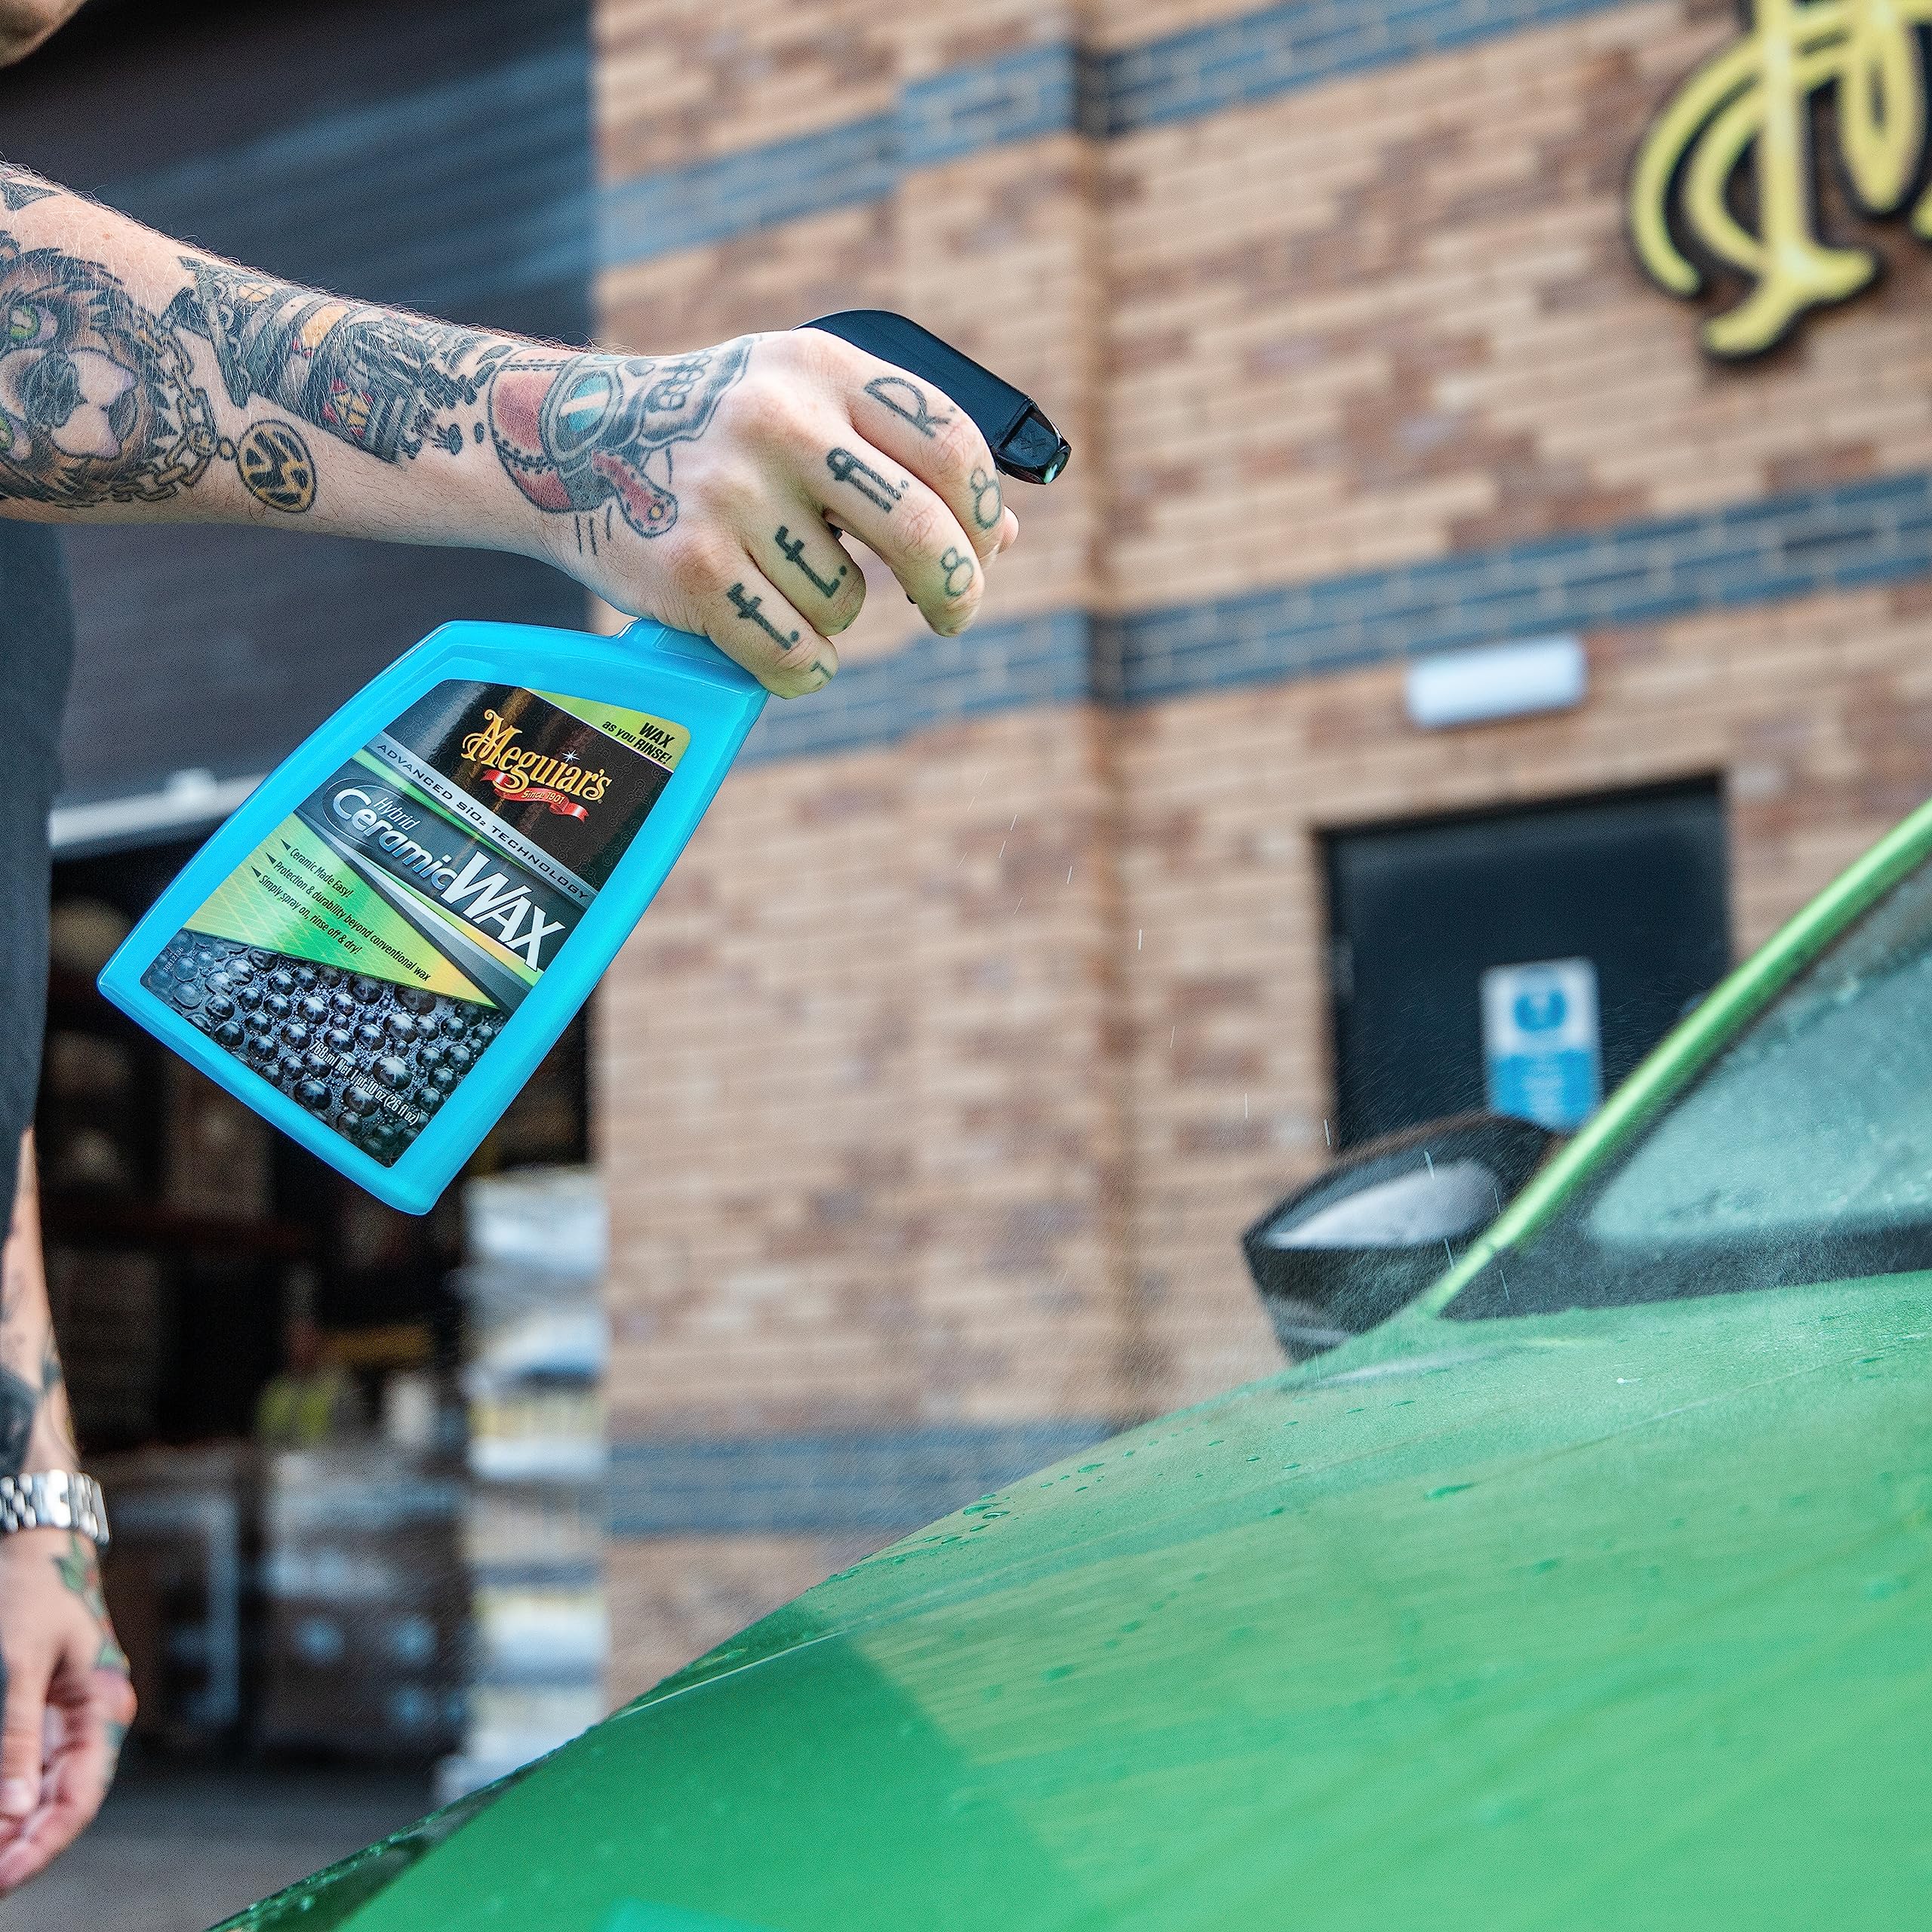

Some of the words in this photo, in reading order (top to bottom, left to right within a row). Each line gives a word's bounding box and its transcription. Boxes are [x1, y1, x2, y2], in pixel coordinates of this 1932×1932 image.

[460, 709, 612, 801] Meguiar's
[601, 721, 617, 732] as
[615, 728, 636, 743] you
[633, 738, 672, 764] RINSE!
[639, 721, 675, 749] WAX
[374, 797, 420, 830] Hybrid
[377, 743, 454, 801] ADVANCED
[491, 824, 589, 900] TECHNOLOGY
[521, 790, 545, 799] Since
[546, 791, 566, 804] 1901
[290, 848, 315, 872] Ceramic
[314, 867, 334, 885] Made
[332, 879, 354, 898] Easy!
[332, 788, 458, 891] Ceramic
[439, 850, 566, 972] WAX
[259, 875, 284, 900] Simply
[280, 892, 303, 912] spray
[298, 906, 310, 919] on,
[309, 914, 330, 931] rinse
[328, 926, 341, 940] off
[338, 934, 347, 943] &
[343, 939, 364, 955] dry!
[274, 861, 312, 891] Protection
[305, 885, 314, 895] &
[311, 889, 347, 920] durability
[343, 913, 374, 939] beyond
[369, 934, 417, 970] conventional
[415, 964, 431, 982] wax
[334, 1058, 353, 1076] Net
[349, 1069, 359, 1080] 1
[365, 1080, 379, 1095] 10
[375, 1090, 387, 1103] oz
[383, 1094, 401, 1112] (26
[397, 1104, 409, 1117] fl
[405, 1111, 420, 1126] oz)
